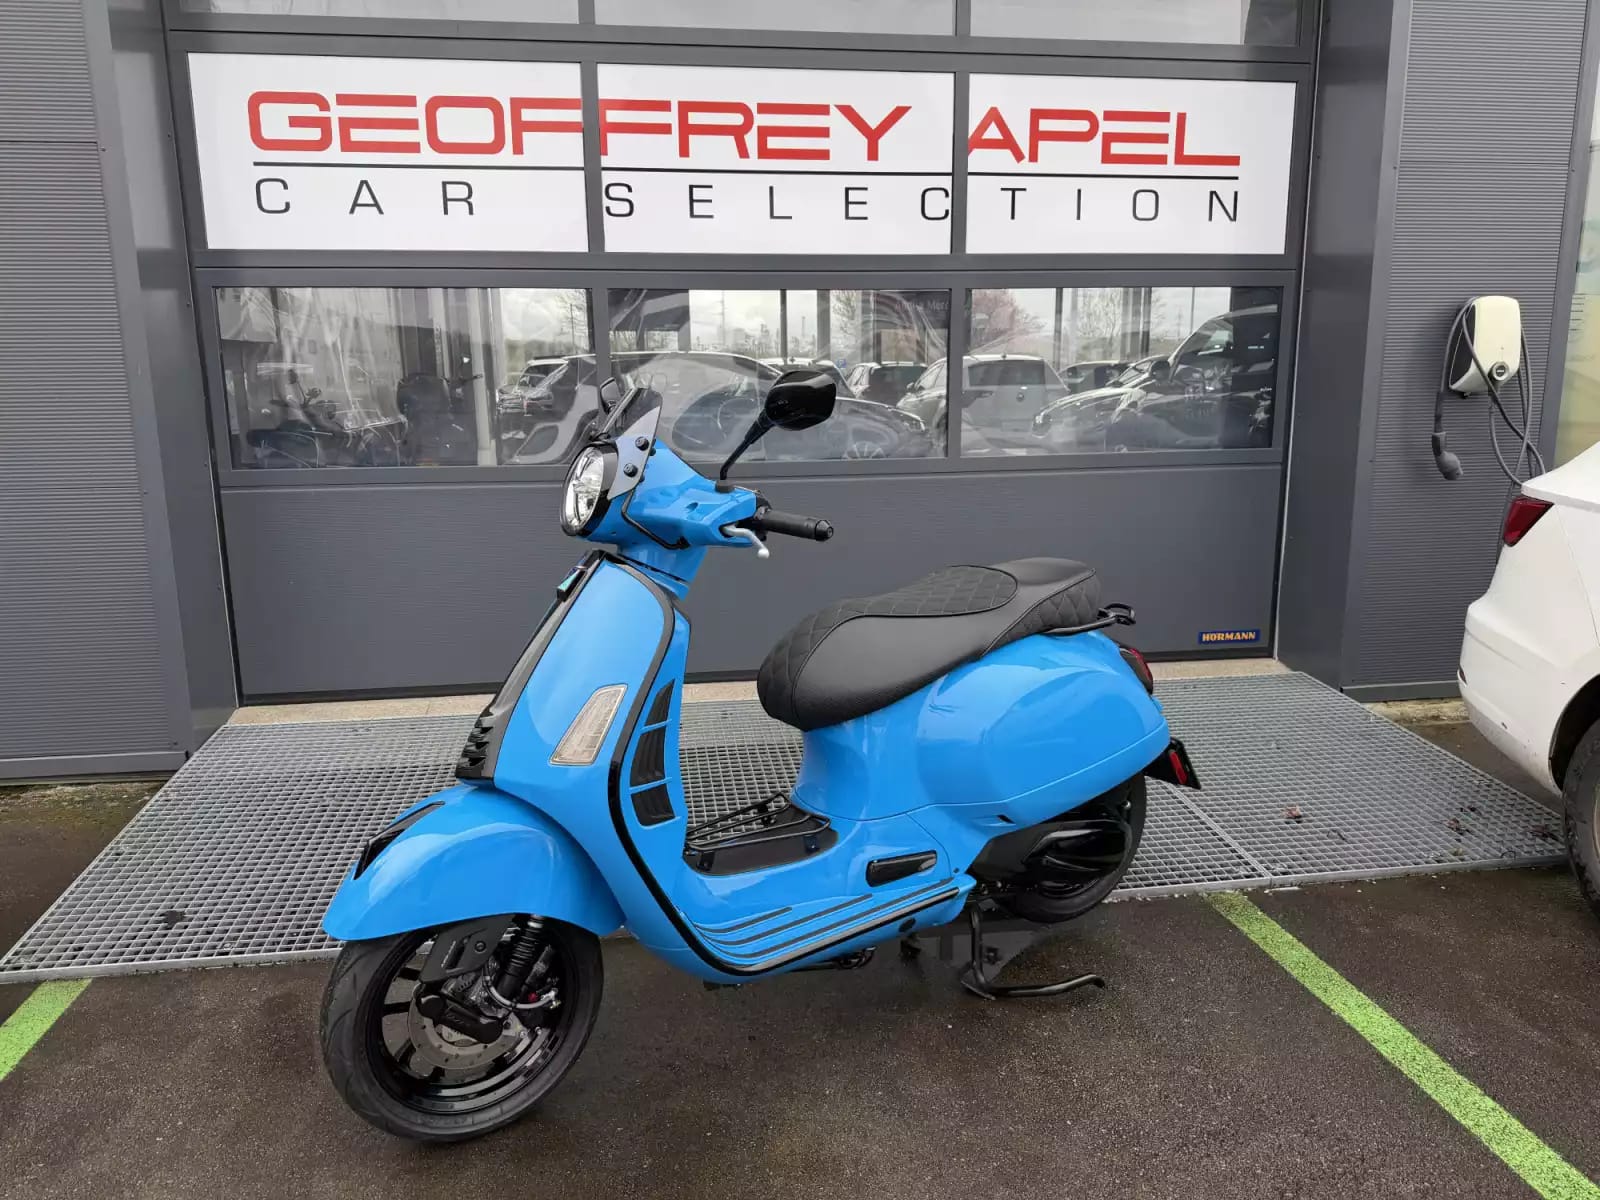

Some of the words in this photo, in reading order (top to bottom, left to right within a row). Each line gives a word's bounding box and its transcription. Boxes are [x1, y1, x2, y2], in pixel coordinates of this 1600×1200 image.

[247, 90, 912, 162] GEOFFREY
[967, 106, 1241, 166] APEL
[255, 177, 475, 216] CAR
[604, 182, 1239, 223] SELECTION
